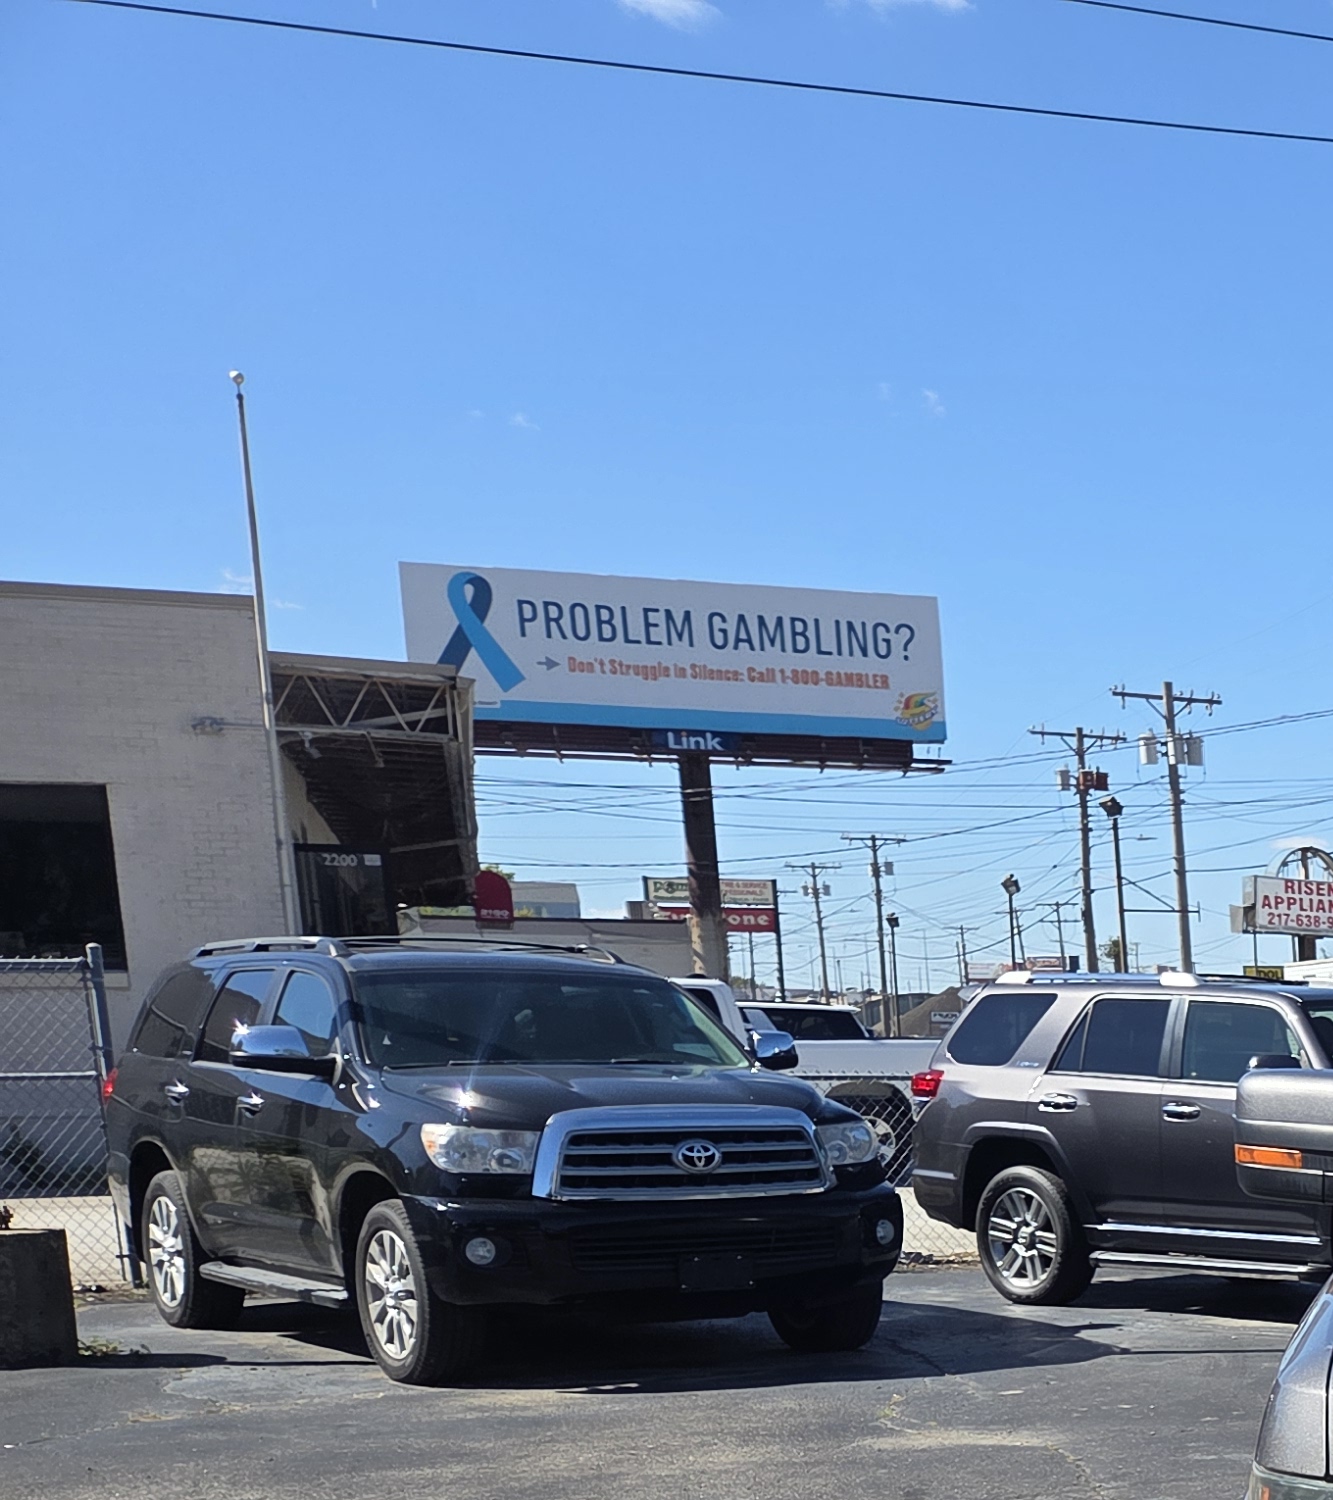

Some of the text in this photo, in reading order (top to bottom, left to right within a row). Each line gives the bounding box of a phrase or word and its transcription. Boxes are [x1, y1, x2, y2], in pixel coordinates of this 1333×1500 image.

[516, 599, 916, 662] PROBLEM GAMBLING?
[567, 656, 890, 690] Don't Struggle in Silence: Call 1-800-GAMBLER
[666, 731, 725, 751] Link
[321, 852, 358, 867] 2200
